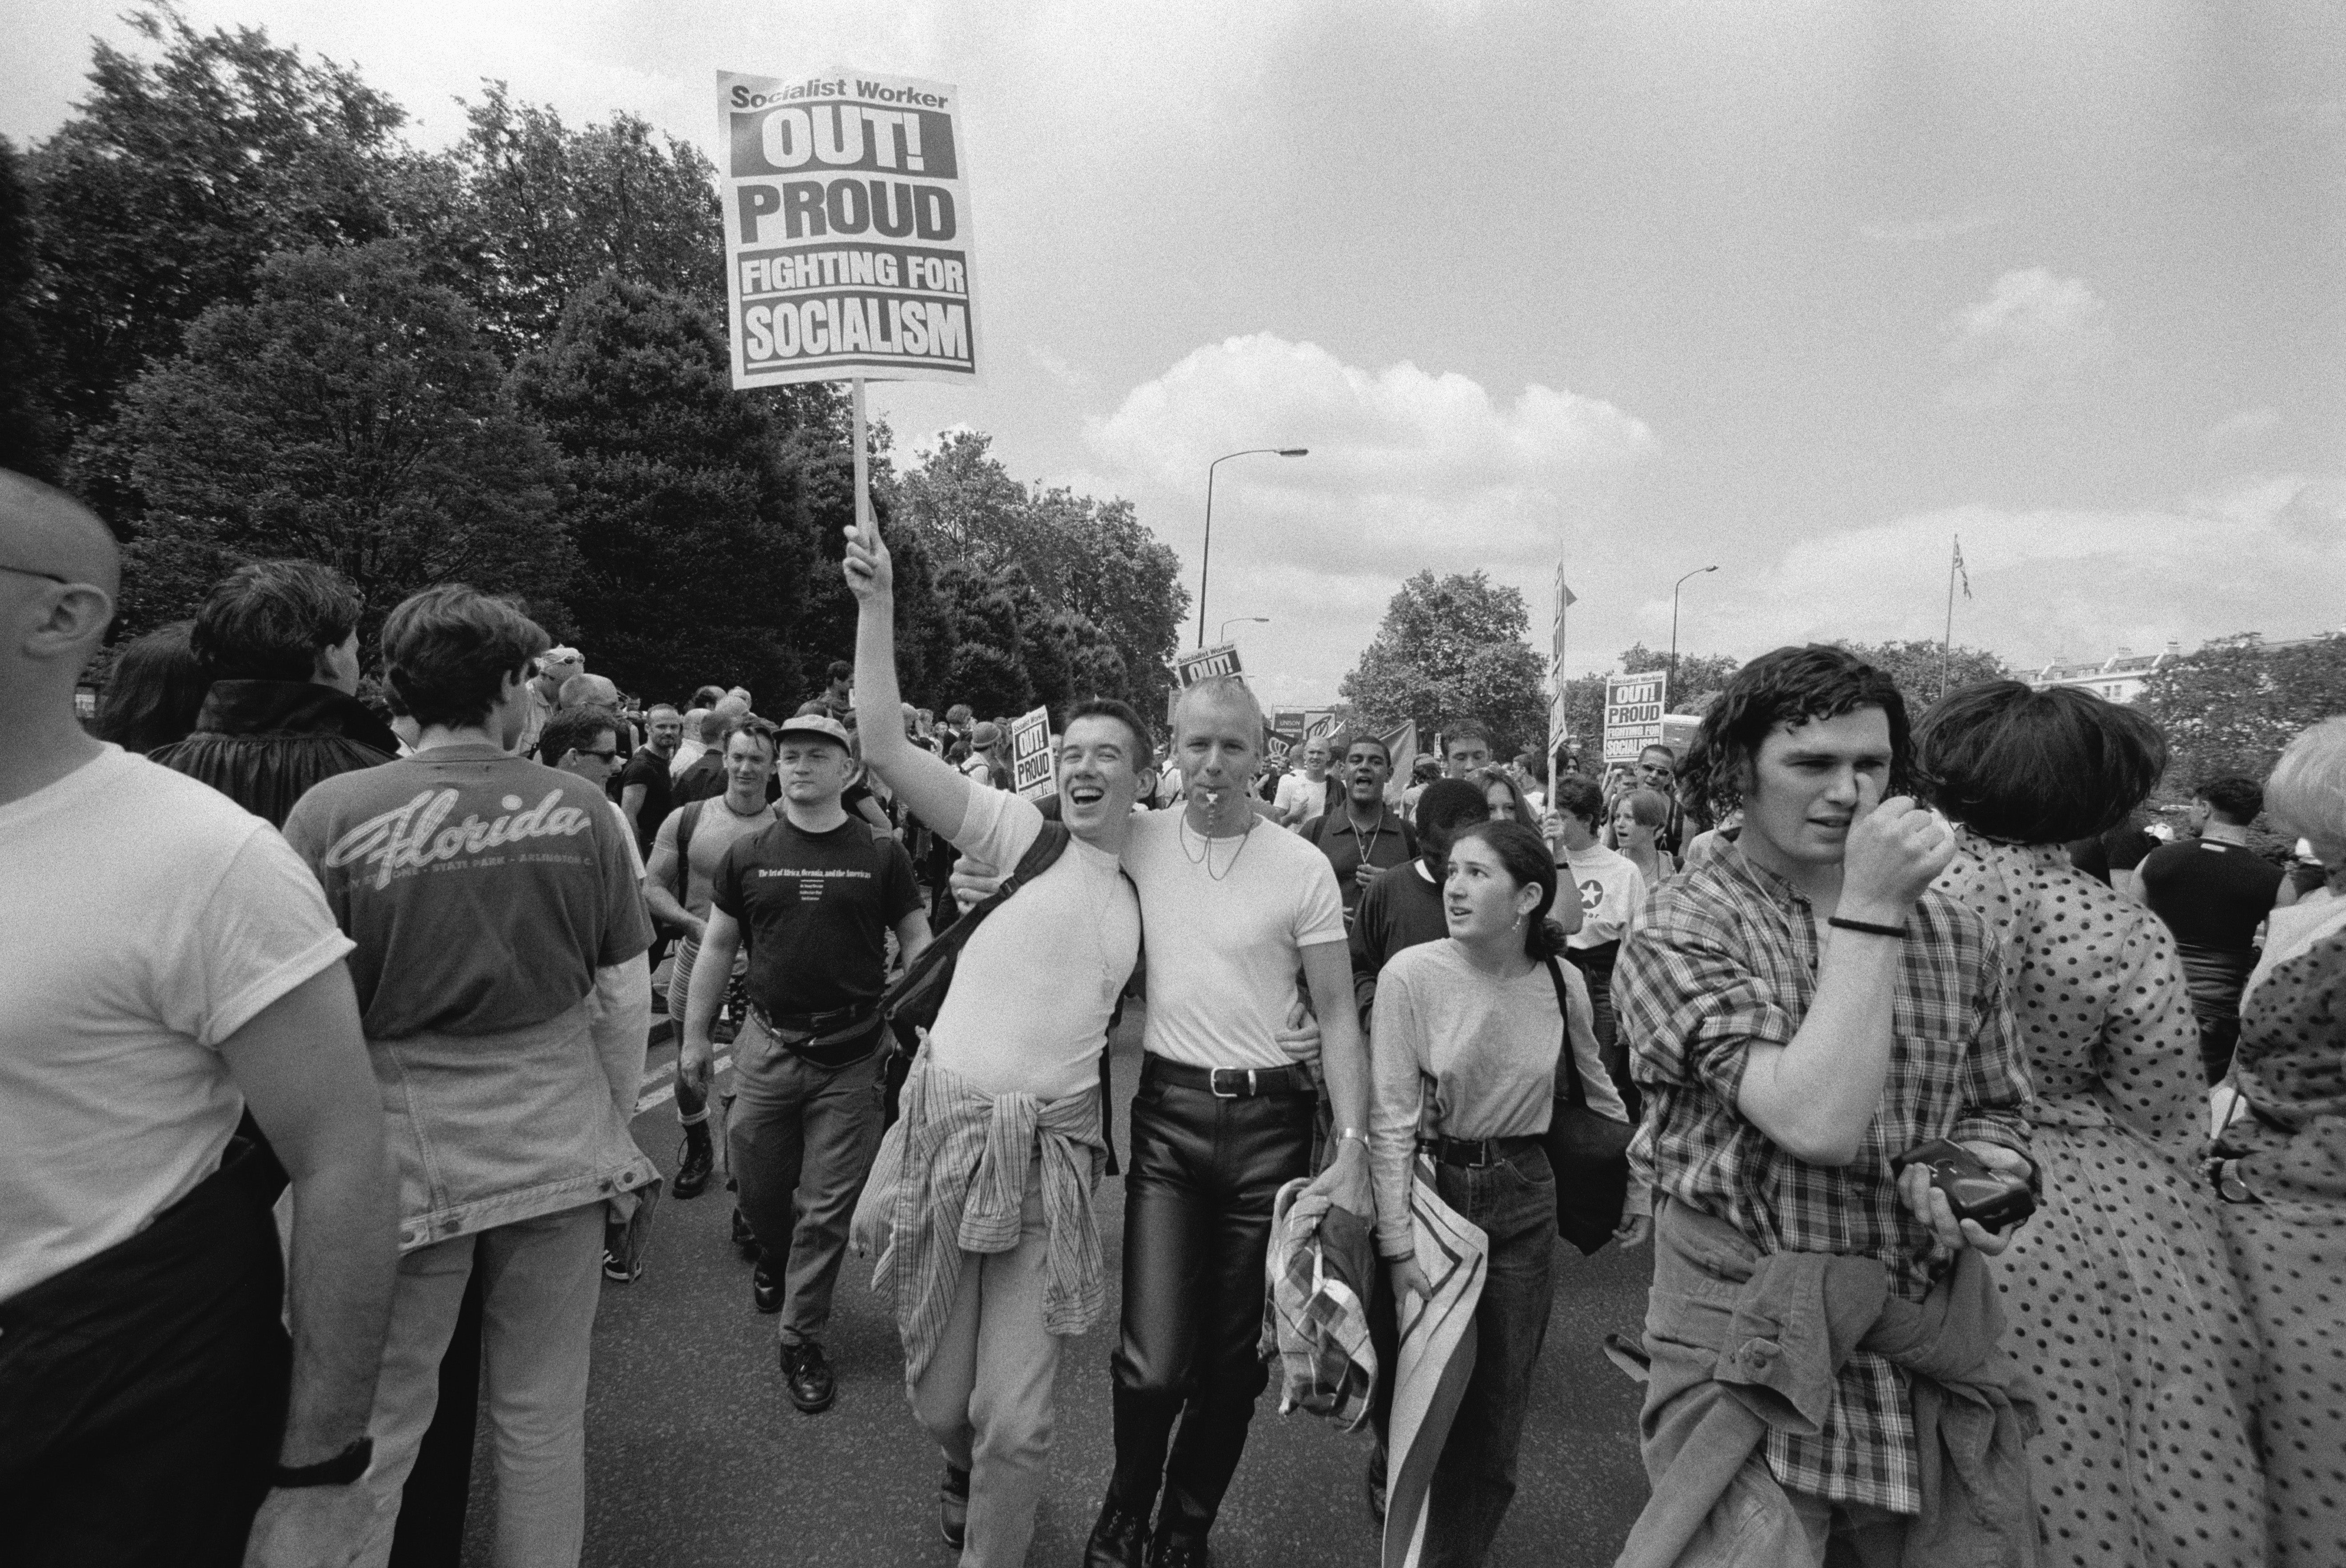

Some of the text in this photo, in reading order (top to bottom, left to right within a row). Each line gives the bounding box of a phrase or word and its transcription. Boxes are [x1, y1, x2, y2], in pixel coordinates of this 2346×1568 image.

[731, 79, 948, 108] Socialist Worker
[762, 105, 924, 171] OUT!
[737, 178, 956, 244] PROUD
[741, 251, 965, 294] FIGHTING FOR
[746, 297, 968, 361] SOCIALISM
[1177, 644, 1235, 665] Socialist Worker
[1188, 654, 1234, 682] OUT!
[1616, 683, 1655, 704] OUT!
[1608, 705, 1660, 724] PROUD
[1019, 723, 1044, 757] OUT!
[1645, 725, 1660, 736] FOR
[1017, 752, 1050, 786] PROUD
[325, 788, 592, 890] Florida
[472, 857, 505, 867] PARK
[758, 869, 768, 878] The
